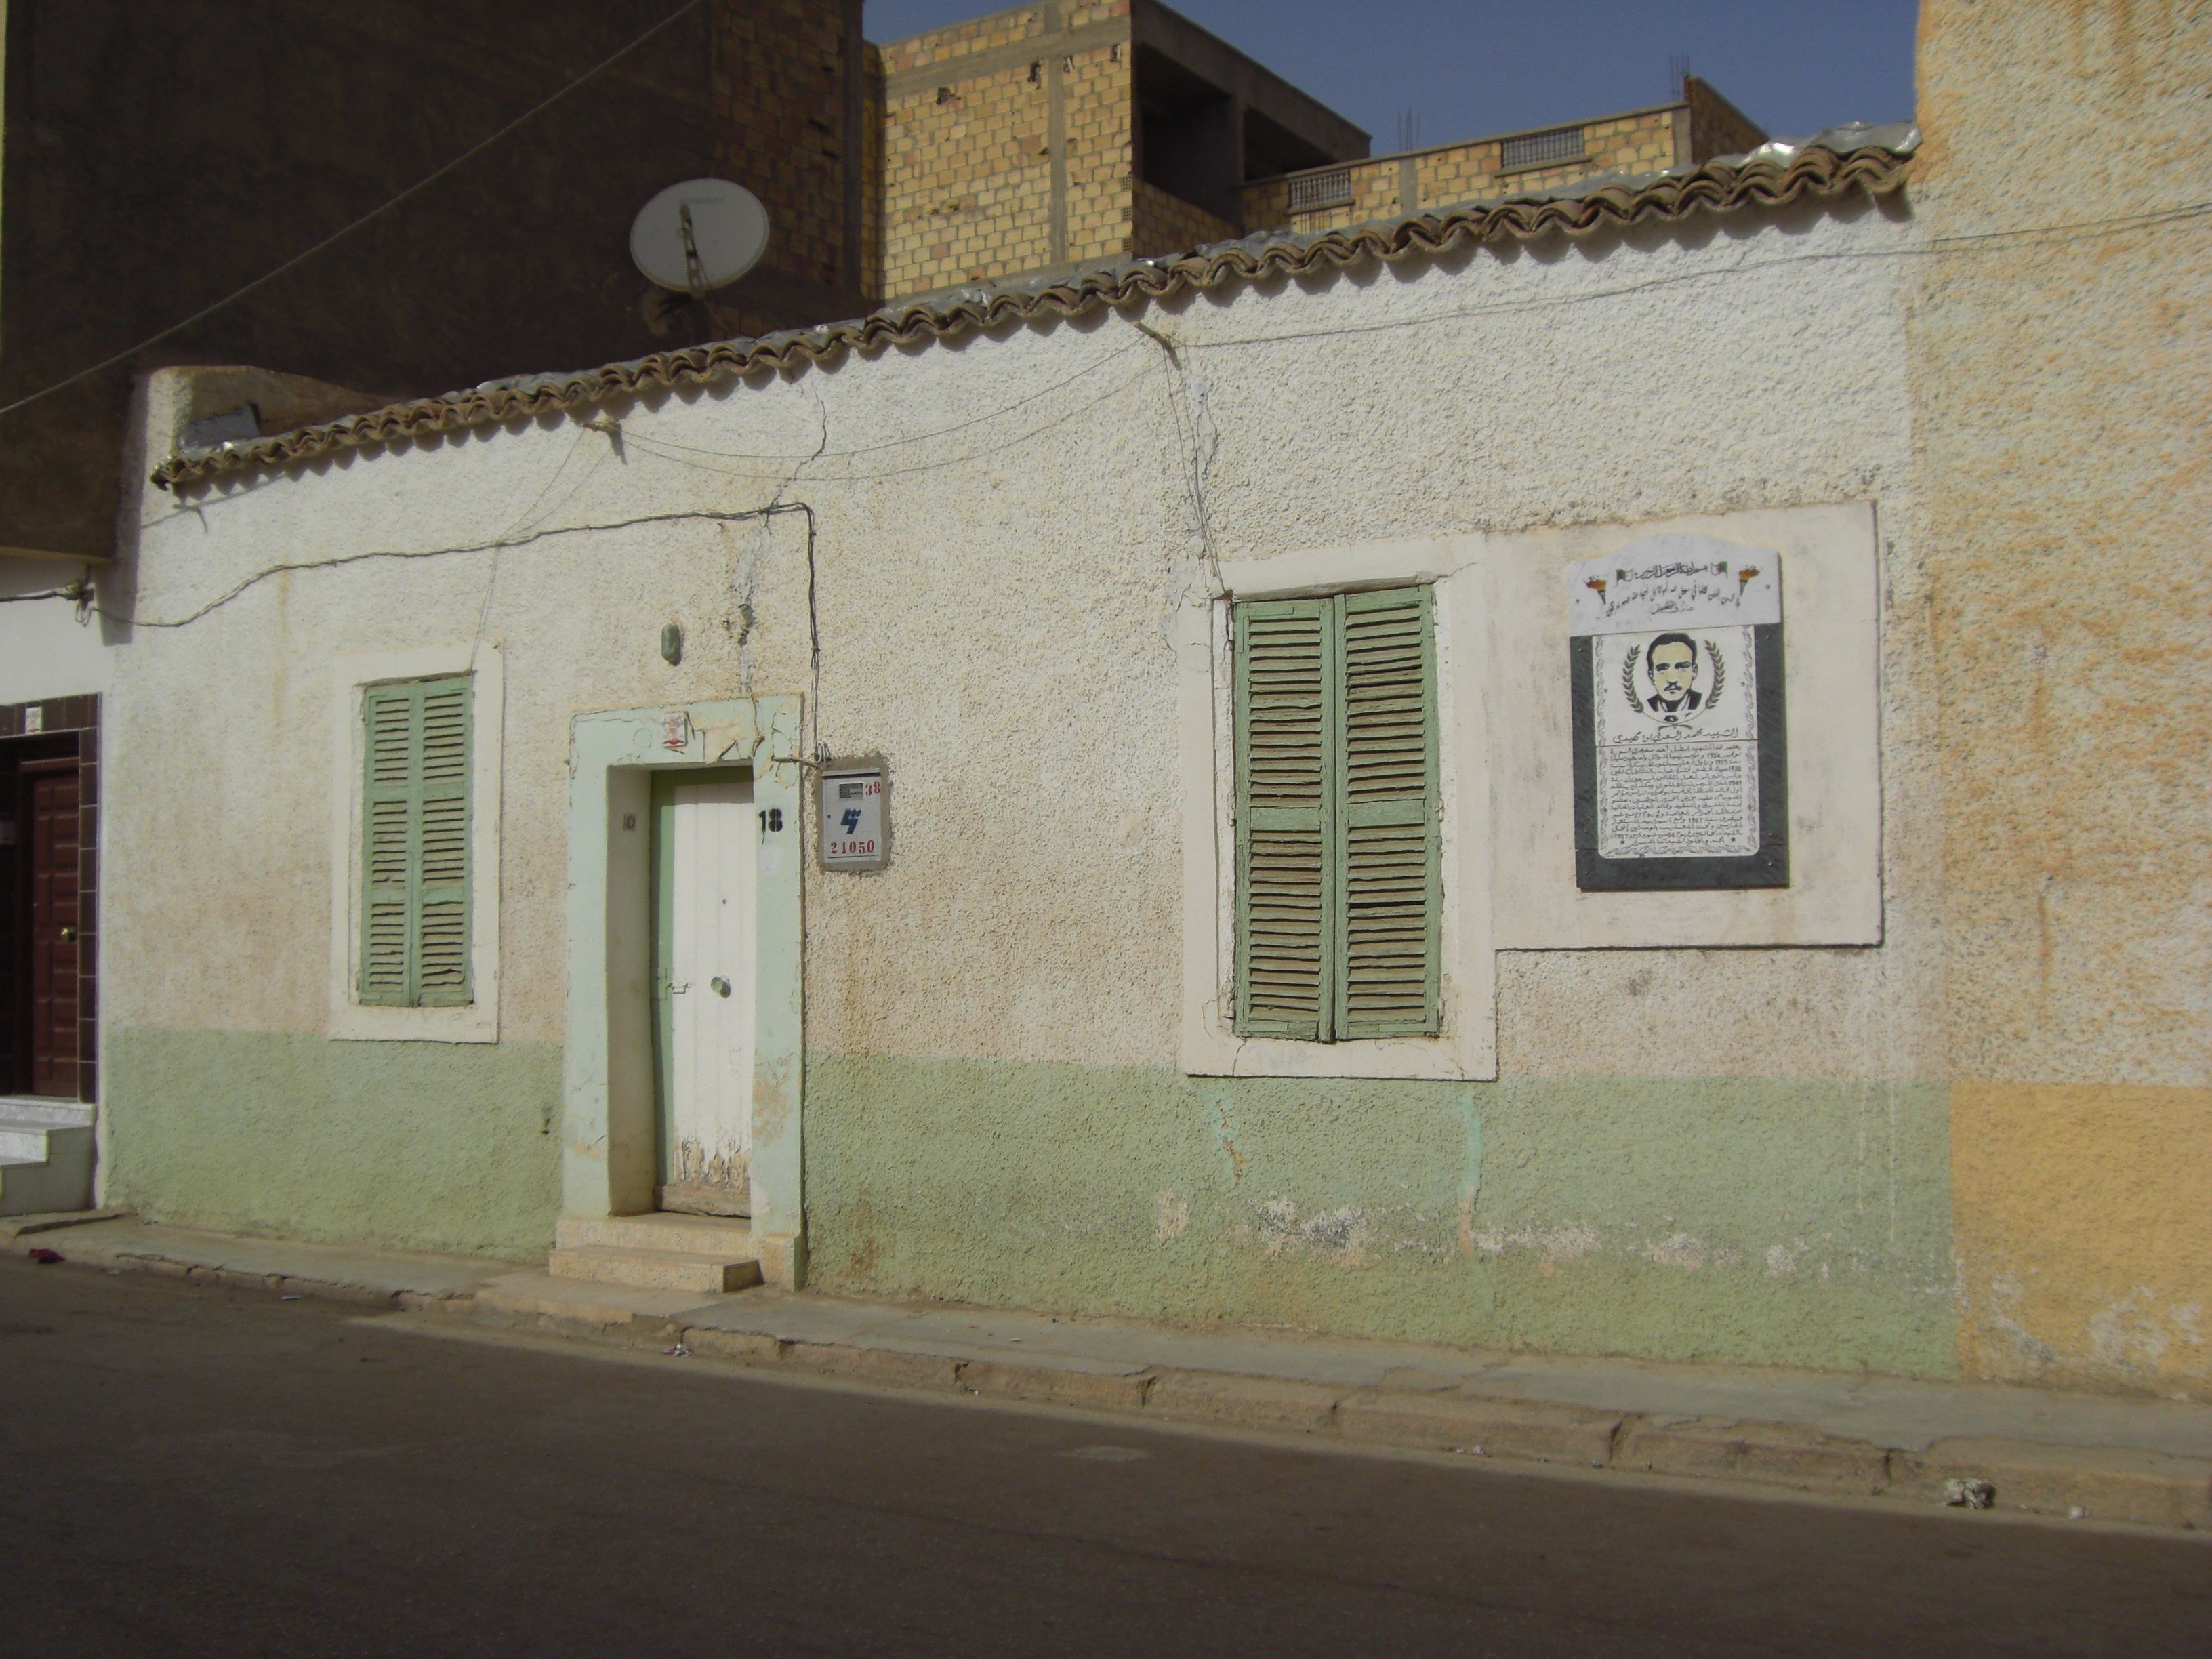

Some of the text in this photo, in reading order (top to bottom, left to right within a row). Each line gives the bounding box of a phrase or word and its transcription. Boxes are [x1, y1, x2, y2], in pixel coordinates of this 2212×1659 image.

[1643, 733, 1653, 743] بن
[1683, 728, 1703, 739] محمد
[1703, 727, 1739, 740] الشهيد
[865, 781, 881, 796] 38
[758, 808, 783, 834] 18
[831, 840, 875, 855] 21050
